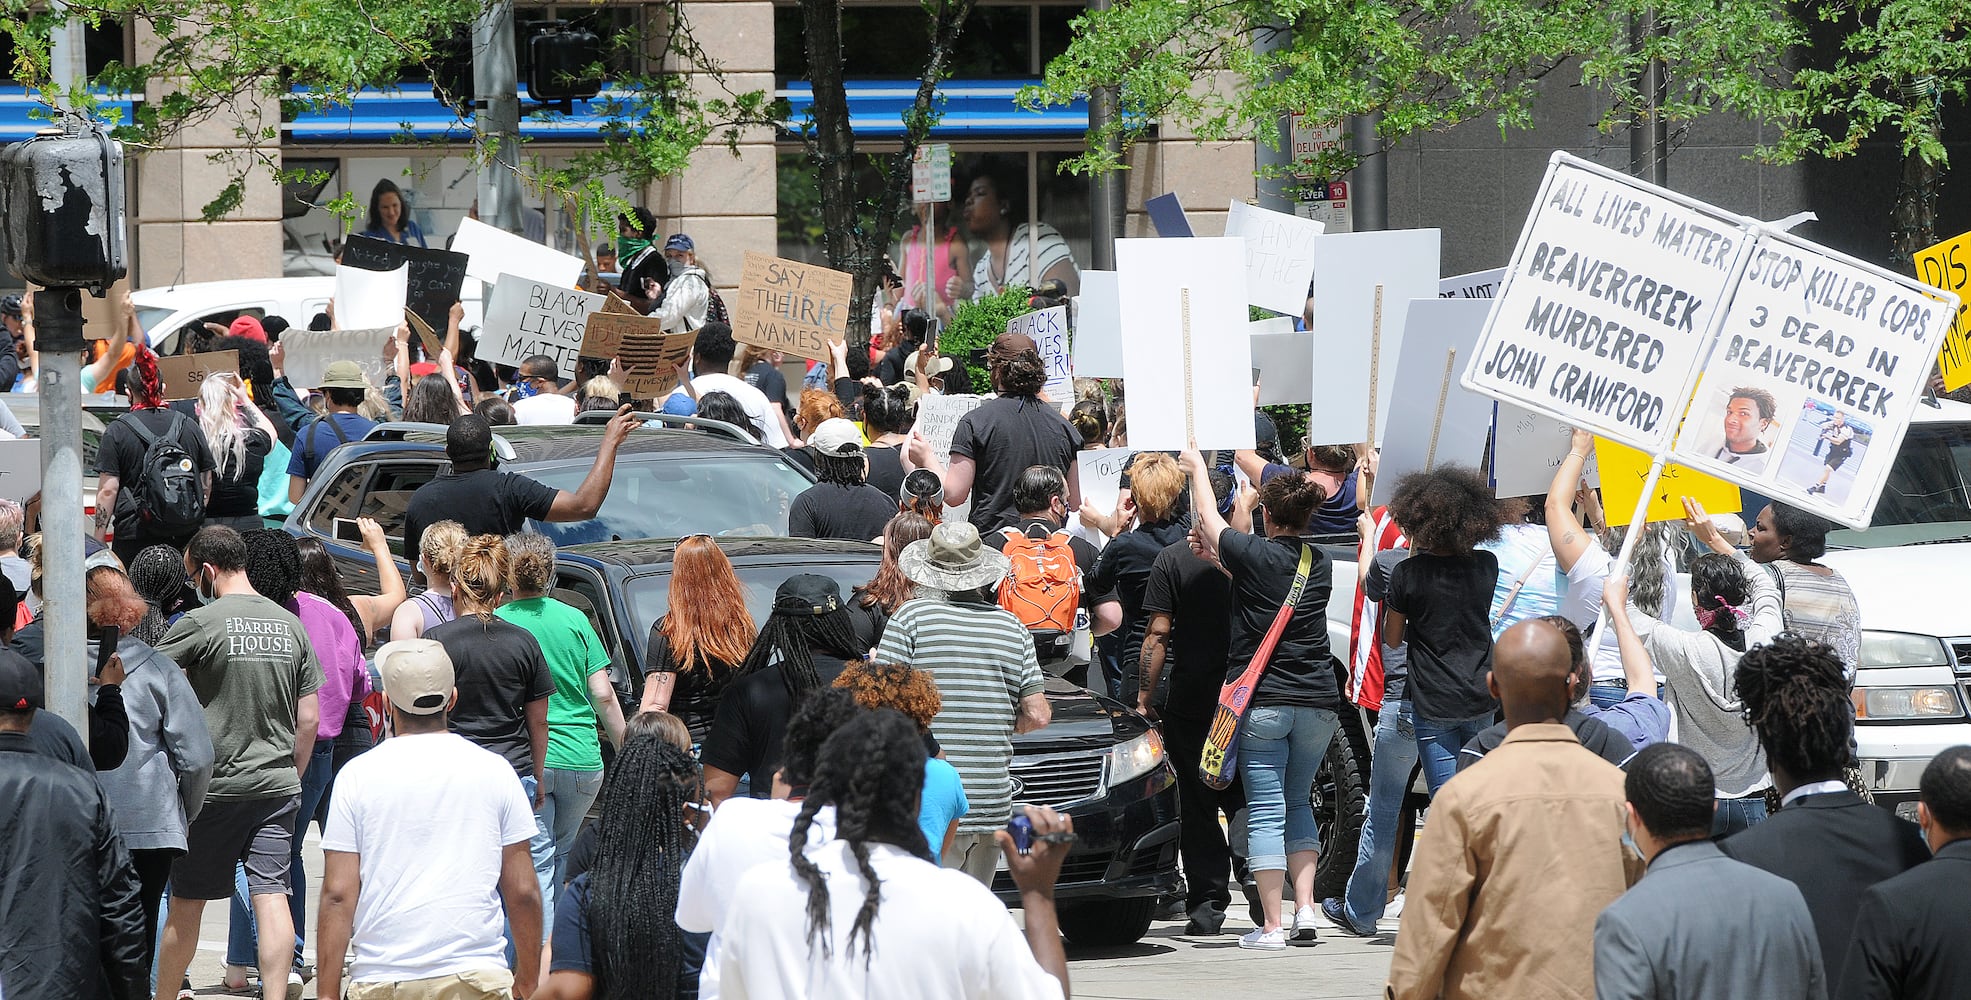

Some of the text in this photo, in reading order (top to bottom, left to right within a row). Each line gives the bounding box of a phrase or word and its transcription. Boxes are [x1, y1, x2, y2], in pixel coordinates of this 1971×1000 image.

[1296, 141, 1338, 153] DELIVERY
[1312, 131, 1322, 140] OR
[1333, 188, 1343, 196] 10
[1549, 178, 1734, 272] ALL LIVES MATTER.
[764, 263, 806, 288] SAY
[1246, 248, 1307, 284] ATHE
[529, 284, 588, 317] BLACK
[1527, 242, 1702, 334] BEAVERCREEK
[1749, 248, 1932, 344] STOP KILLER COPS.
[520, 311, 585, 342] LIVES
[755, 320, 822, 351] NAMES
[1012, 311, 1059, 335] BLACK
[1525, 296, 1665, 374] MURDERED
[501, 334, 579, 372] MATTE
[1034, 335, 1061, 356] VES
[1750, 305, 1899, 377] 3 DEAD IN
[1044, 354, 1071, 377] ER!
[1725, 334, 1894, 419] BEAVERCREEK
[1484, 340, 1546, 390] JOHN
[1549, 362, 1664, 434] CRAWFORD.
[227, 635, 293, 656] HOUSE
